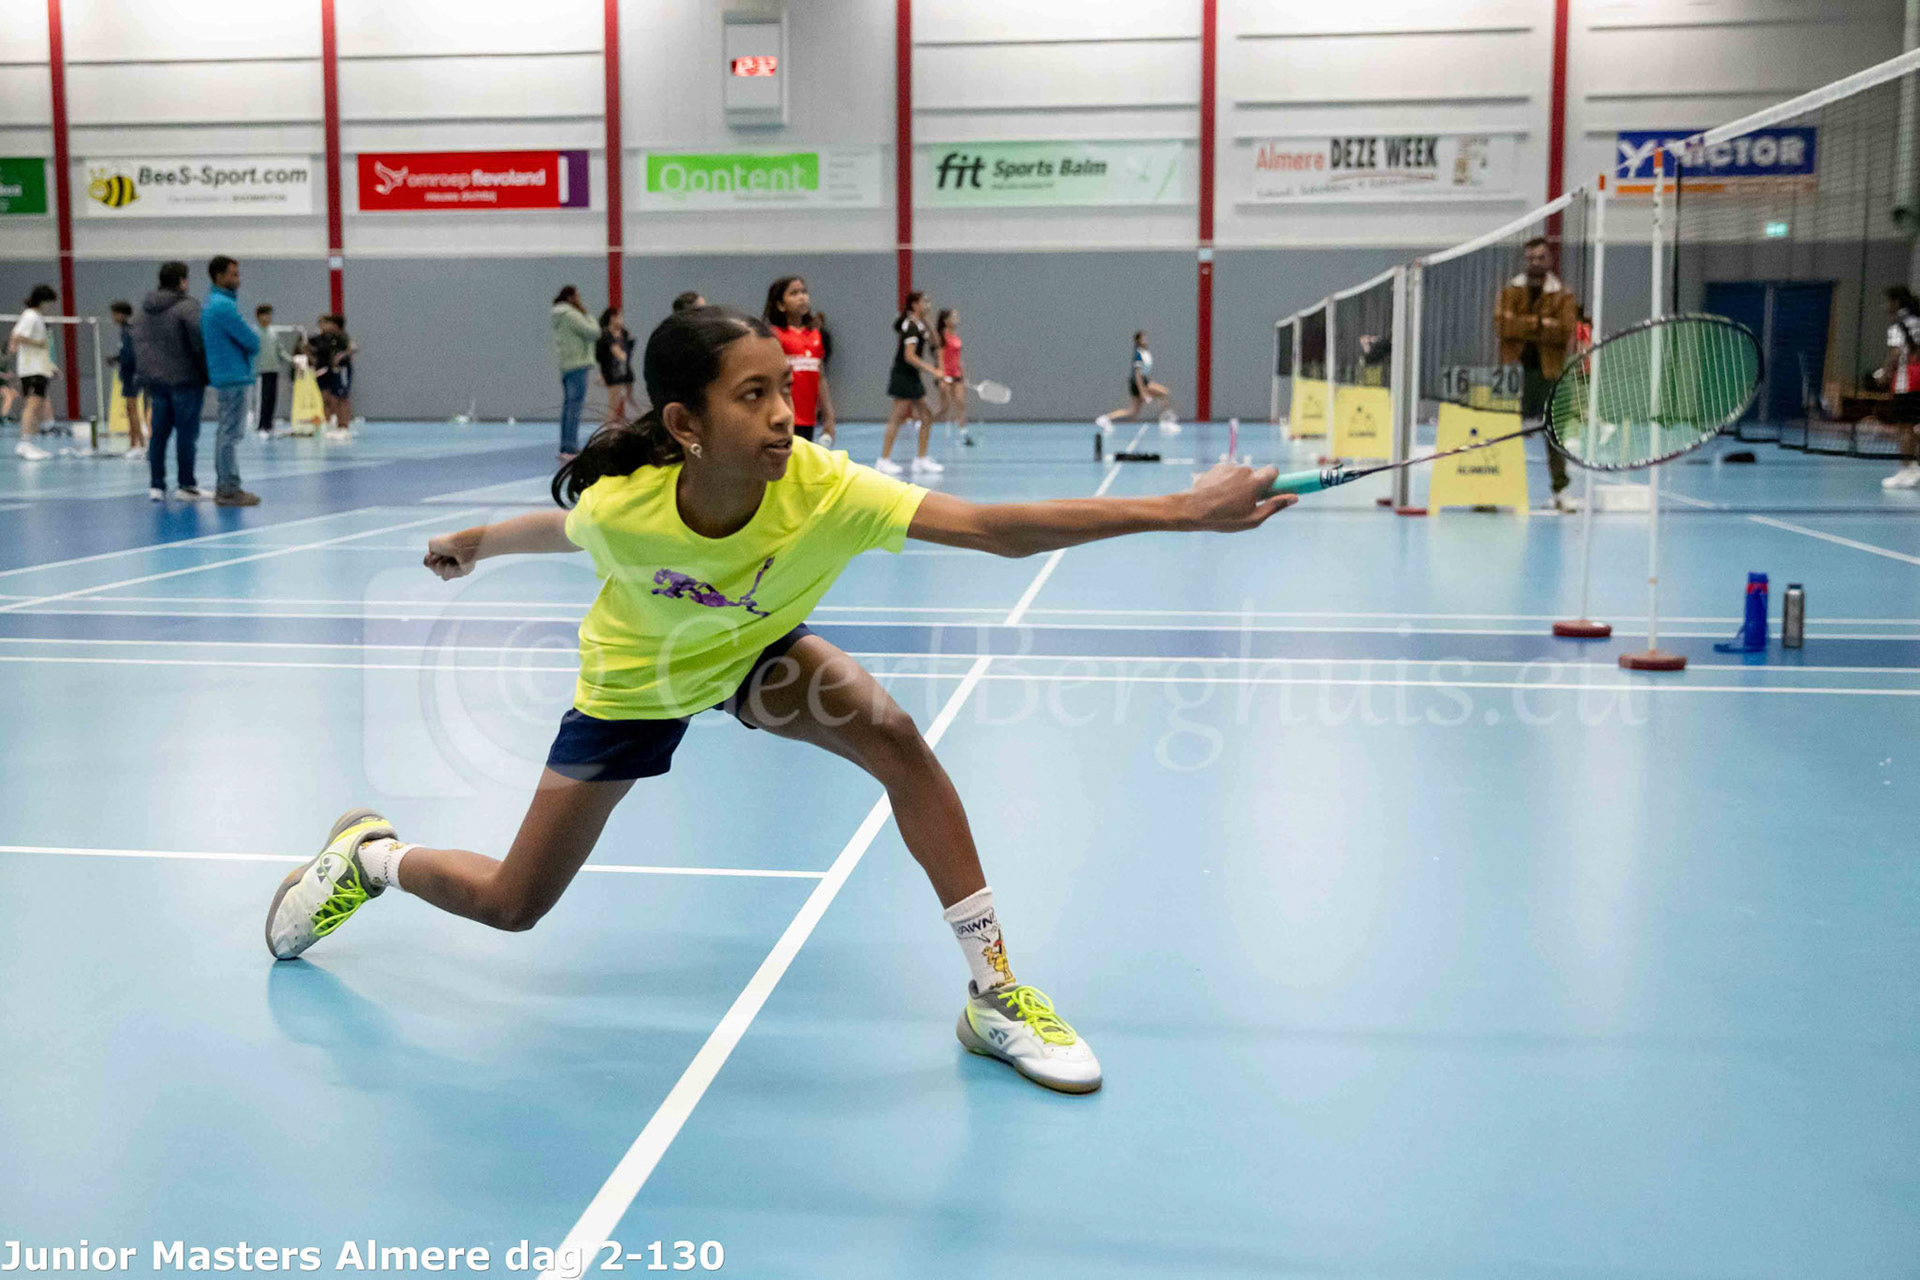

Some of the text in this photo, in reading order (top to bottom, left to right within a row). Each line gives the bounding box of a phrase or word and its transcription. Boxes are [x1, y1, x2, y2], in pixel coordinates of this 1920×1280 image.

[937, 153, 1108, 189] fit Sports Balm
[1256, 136, 1439, 171] Almere DEZE WEEK
[138, 164, 308, 188] BeeS-Sport.com
[660, 162, 807, 197] Qontent
[1441, 367, 1519, 394] 16 20
